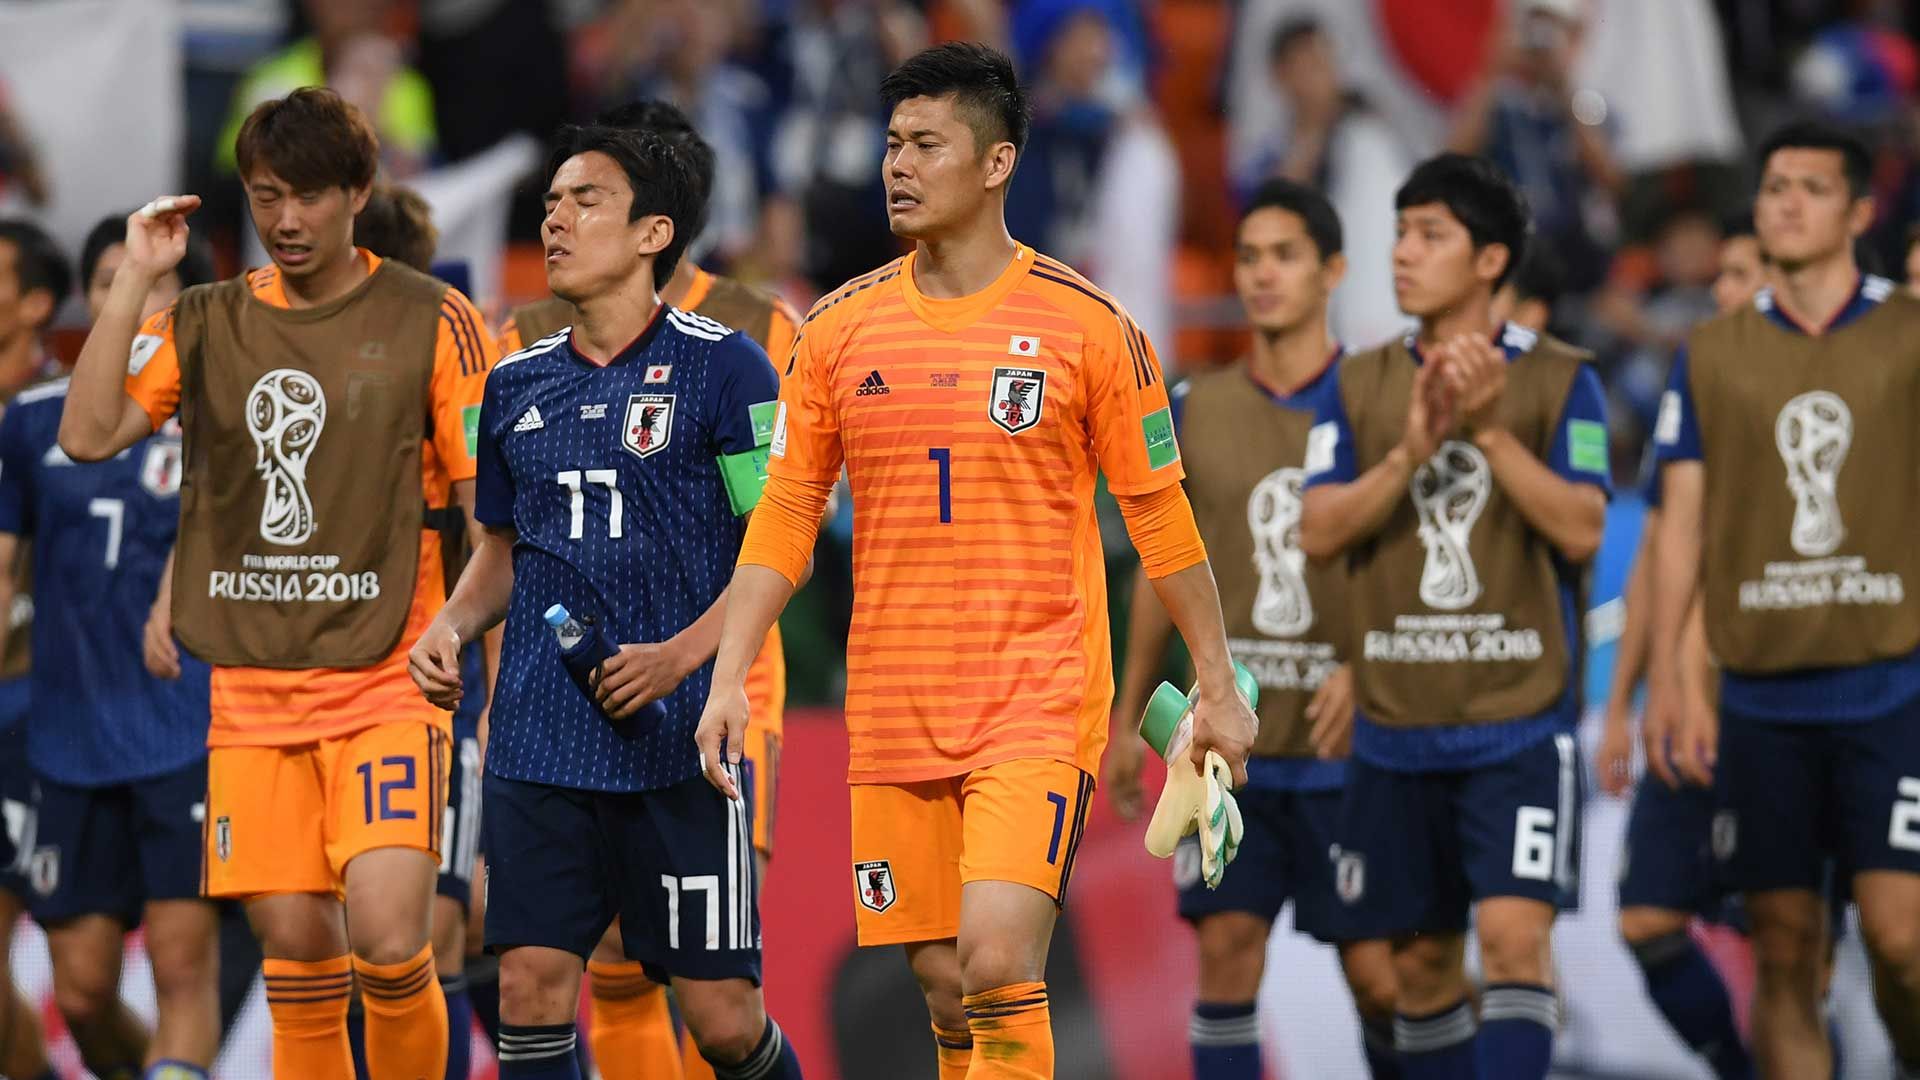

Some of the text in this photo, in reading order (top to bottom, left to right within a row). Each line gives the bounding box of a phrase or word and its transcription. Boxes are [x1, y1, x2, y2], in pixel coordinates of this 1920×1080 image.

[513, 420, 545, 432] adidas
[855, 385, 890, 397] adidas
[1002, 411, 1025, 423] JFA
[634, 435, 655, 446] JFA
[557, 469, 623, 539] 17
[928, 448, 951, 523] 1
[89, 498, 124, 569] 7
[310, 555, 340, 570] CUP
[208, 571, 381, 601] RUSSIA 2018
[356, 755, 416, 825] 12
[1046, 790, 1068, 866] 1
[1511, 805, 1556, 881] 6
[661, 873, 720, 951] 17
